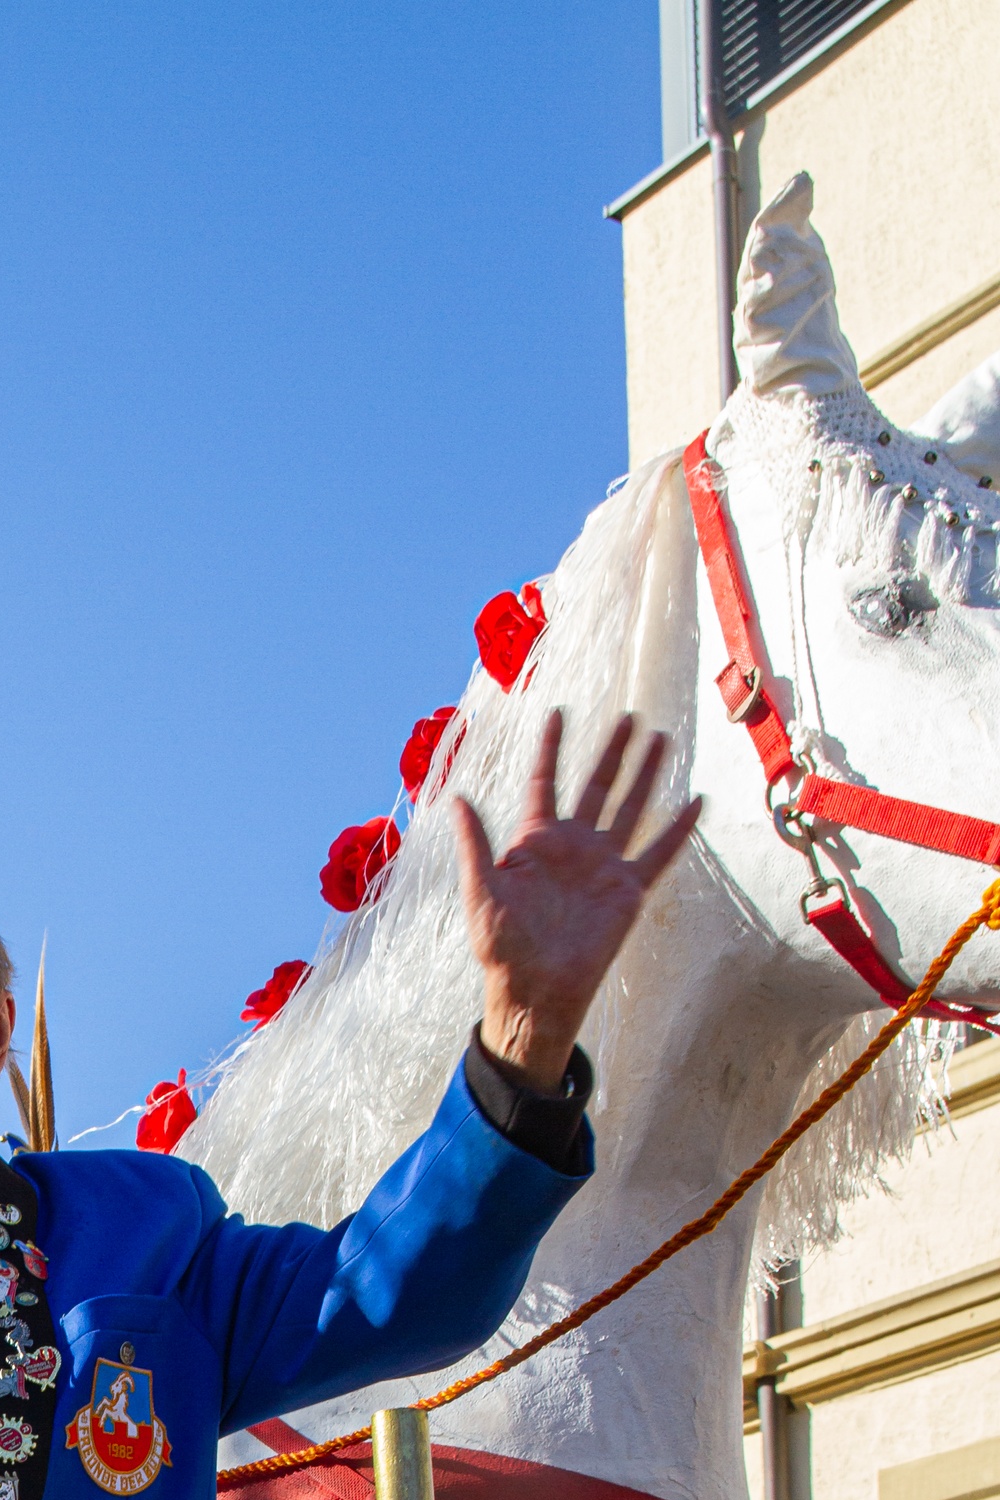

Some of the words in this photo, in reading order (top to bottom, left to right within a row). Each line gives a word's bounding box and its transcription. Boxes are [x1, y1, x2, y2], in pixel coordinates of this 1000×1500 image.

[79, 1426, 118, 1490] FREUNDE
[121, 1472, 145, 1490] DER
[107, 1443, 134, 1460] 1982
